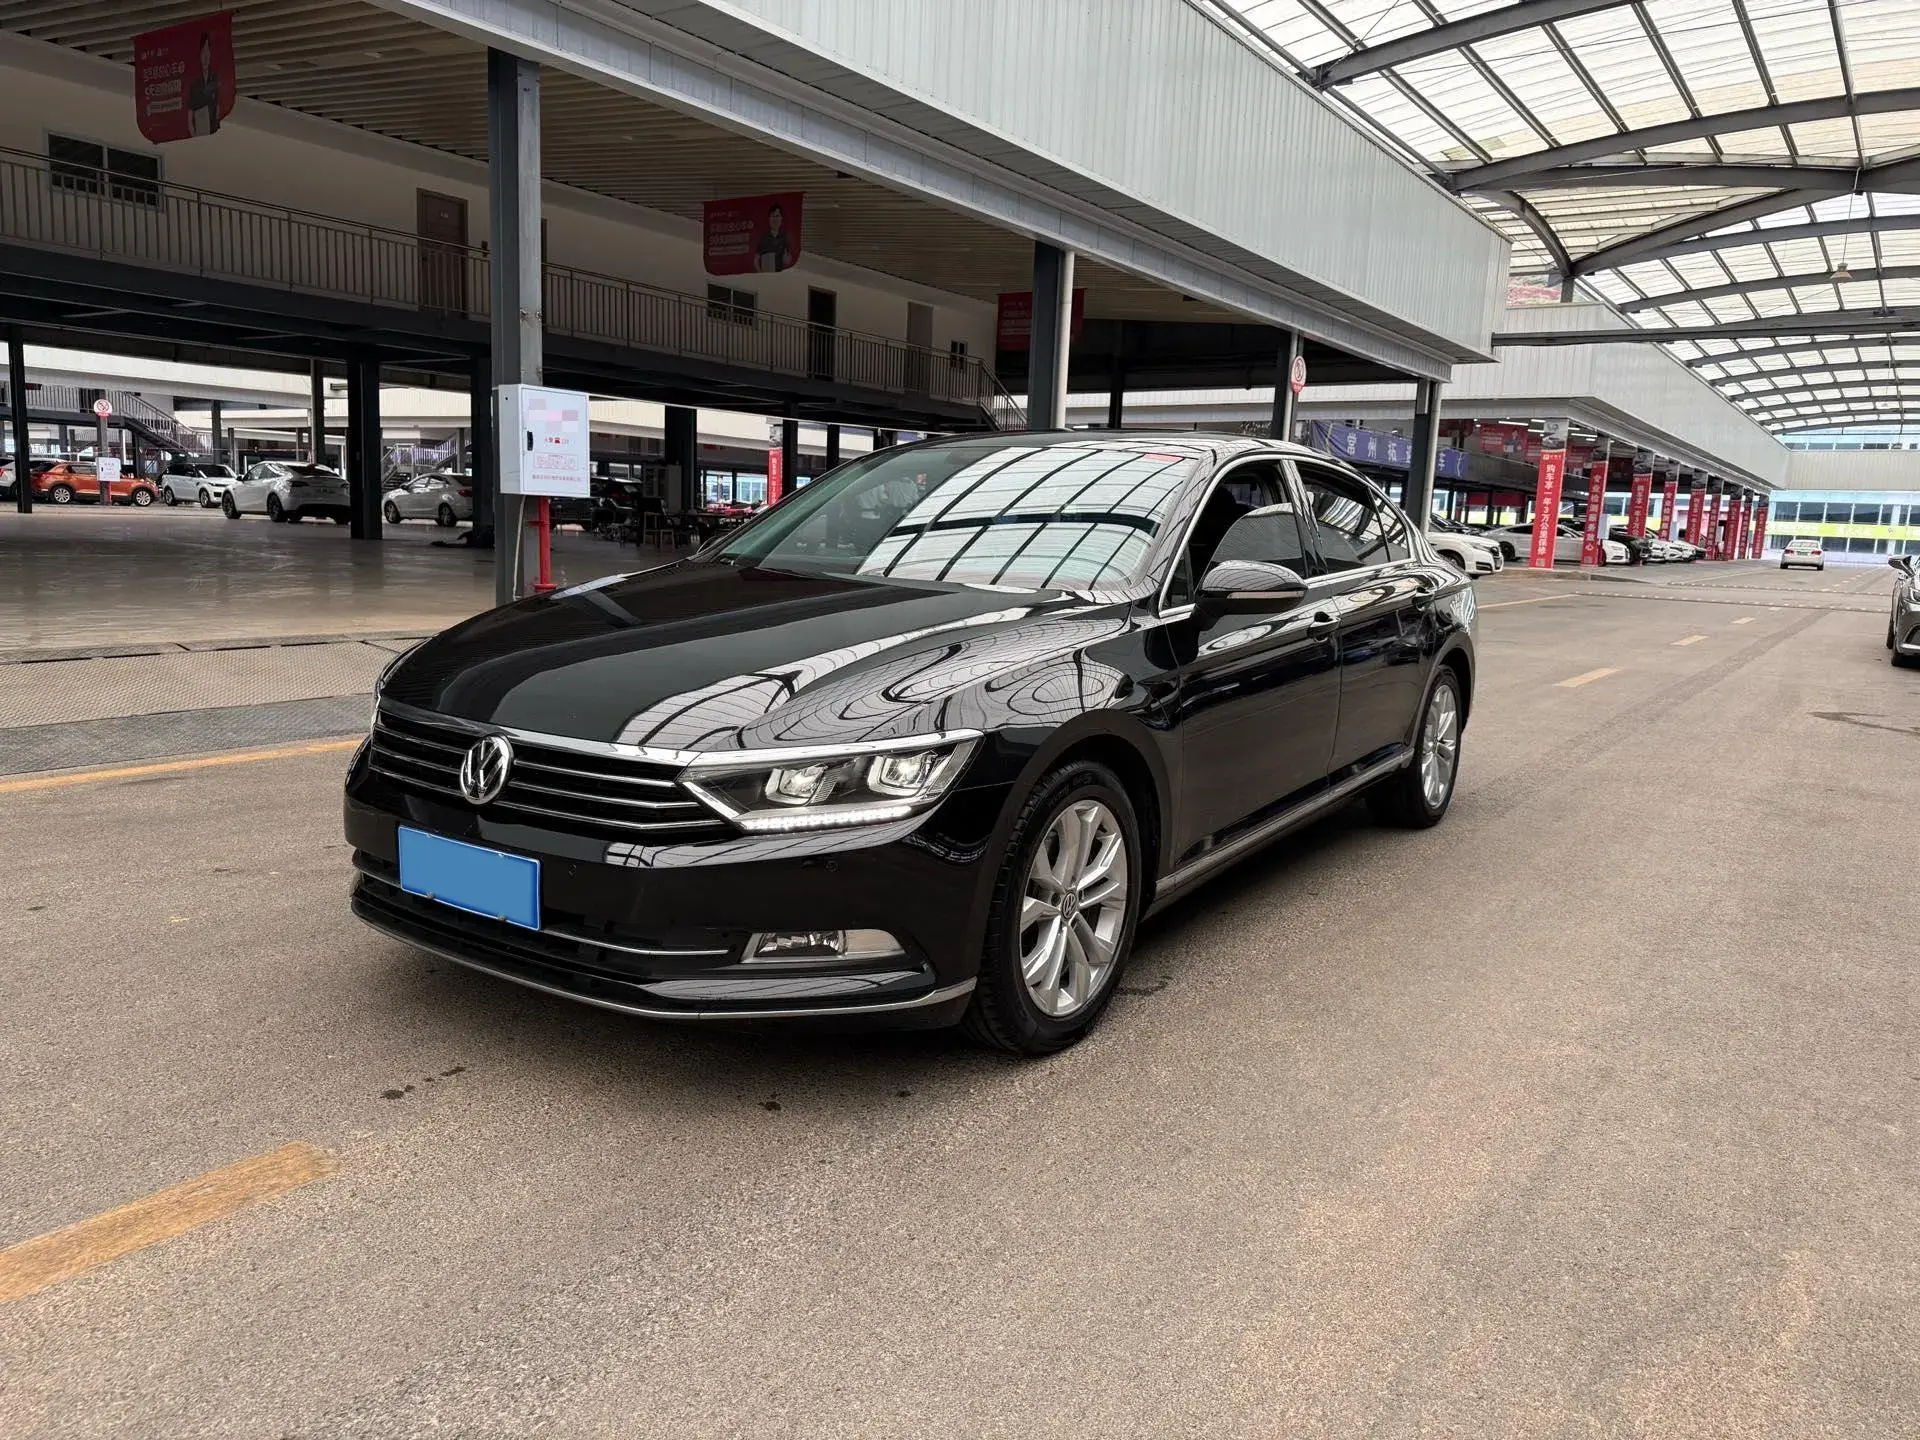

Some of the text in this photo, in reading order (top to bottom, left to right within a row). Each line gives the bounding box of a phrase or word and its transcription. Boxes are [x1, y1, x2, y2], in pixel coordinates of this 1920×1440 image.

[1537, 464, 1556, 555] 购车享一年3万公里保修
